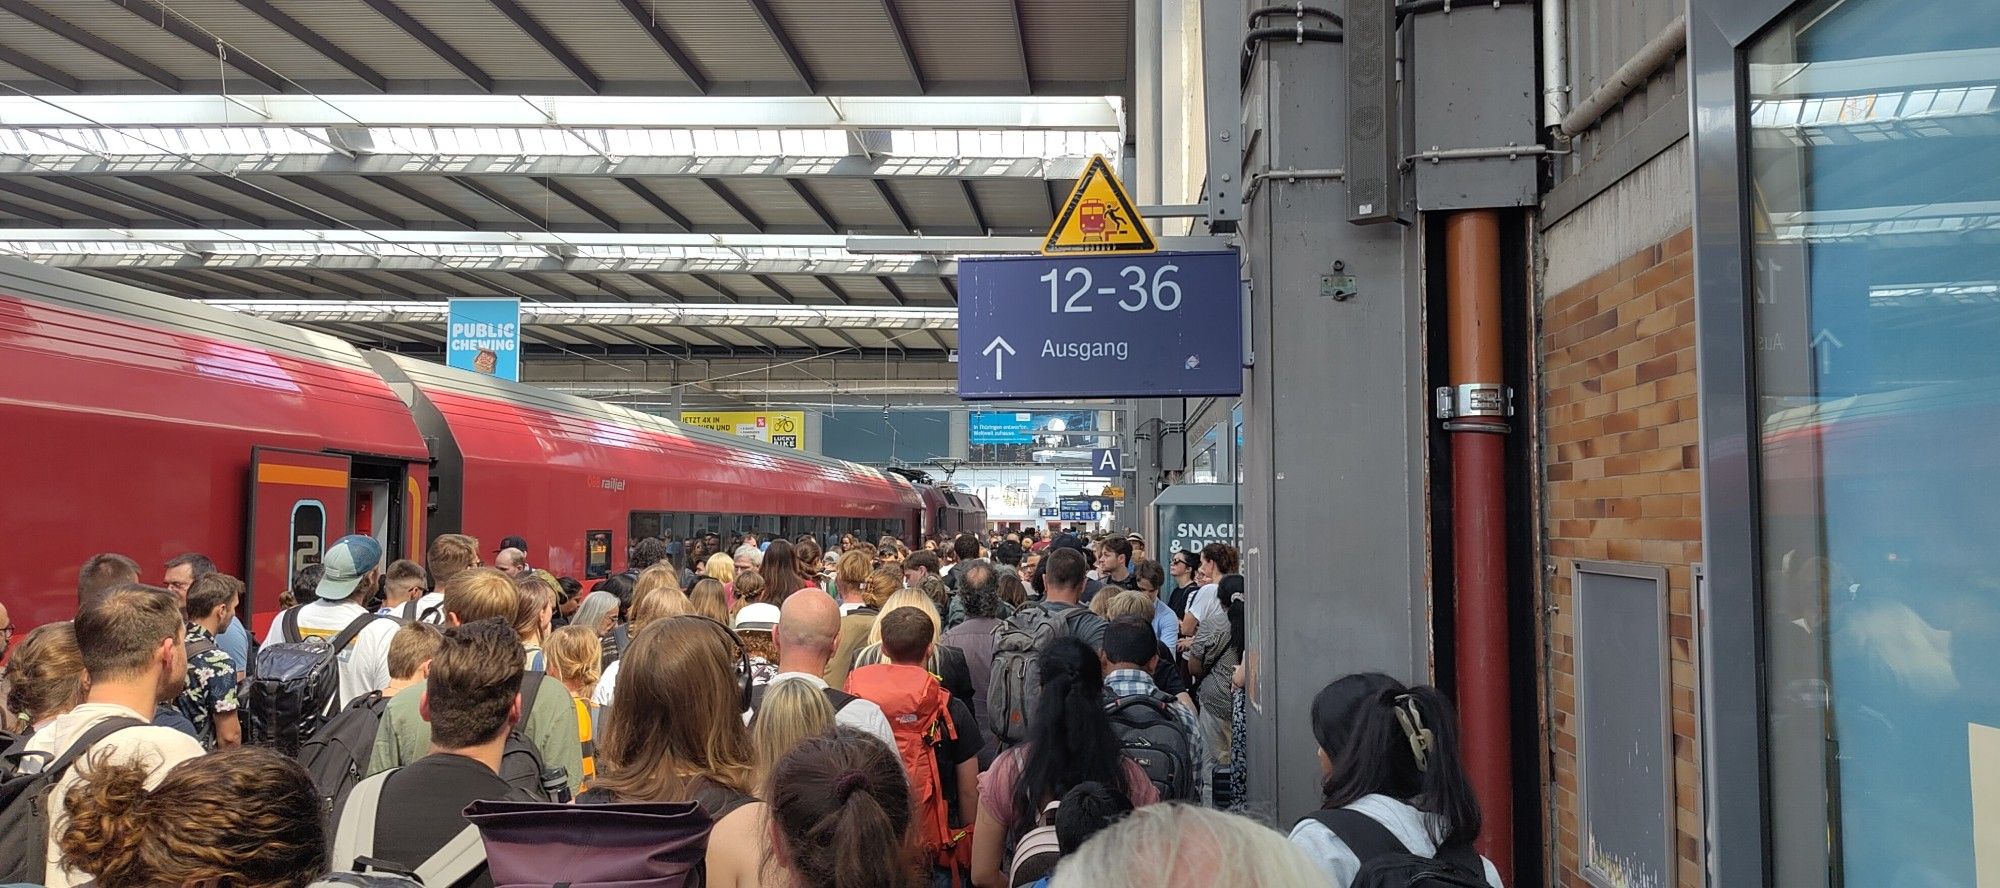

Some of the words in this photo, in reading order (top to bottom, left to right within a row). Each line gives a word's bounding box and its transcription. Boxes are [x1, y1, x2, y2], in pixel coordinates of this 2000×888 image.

[1040, 265, 1182, 313] 12-36
[453, 323, 515, 338] PUBLIC
[451, 339, 515, 351] CHEWING
[1041, 339, 1128, 361] Ausgang
[1099, 449, 1116, 471] A
[297, 536, 319, 571] 2
[1170, 539, 1182, 553] &
